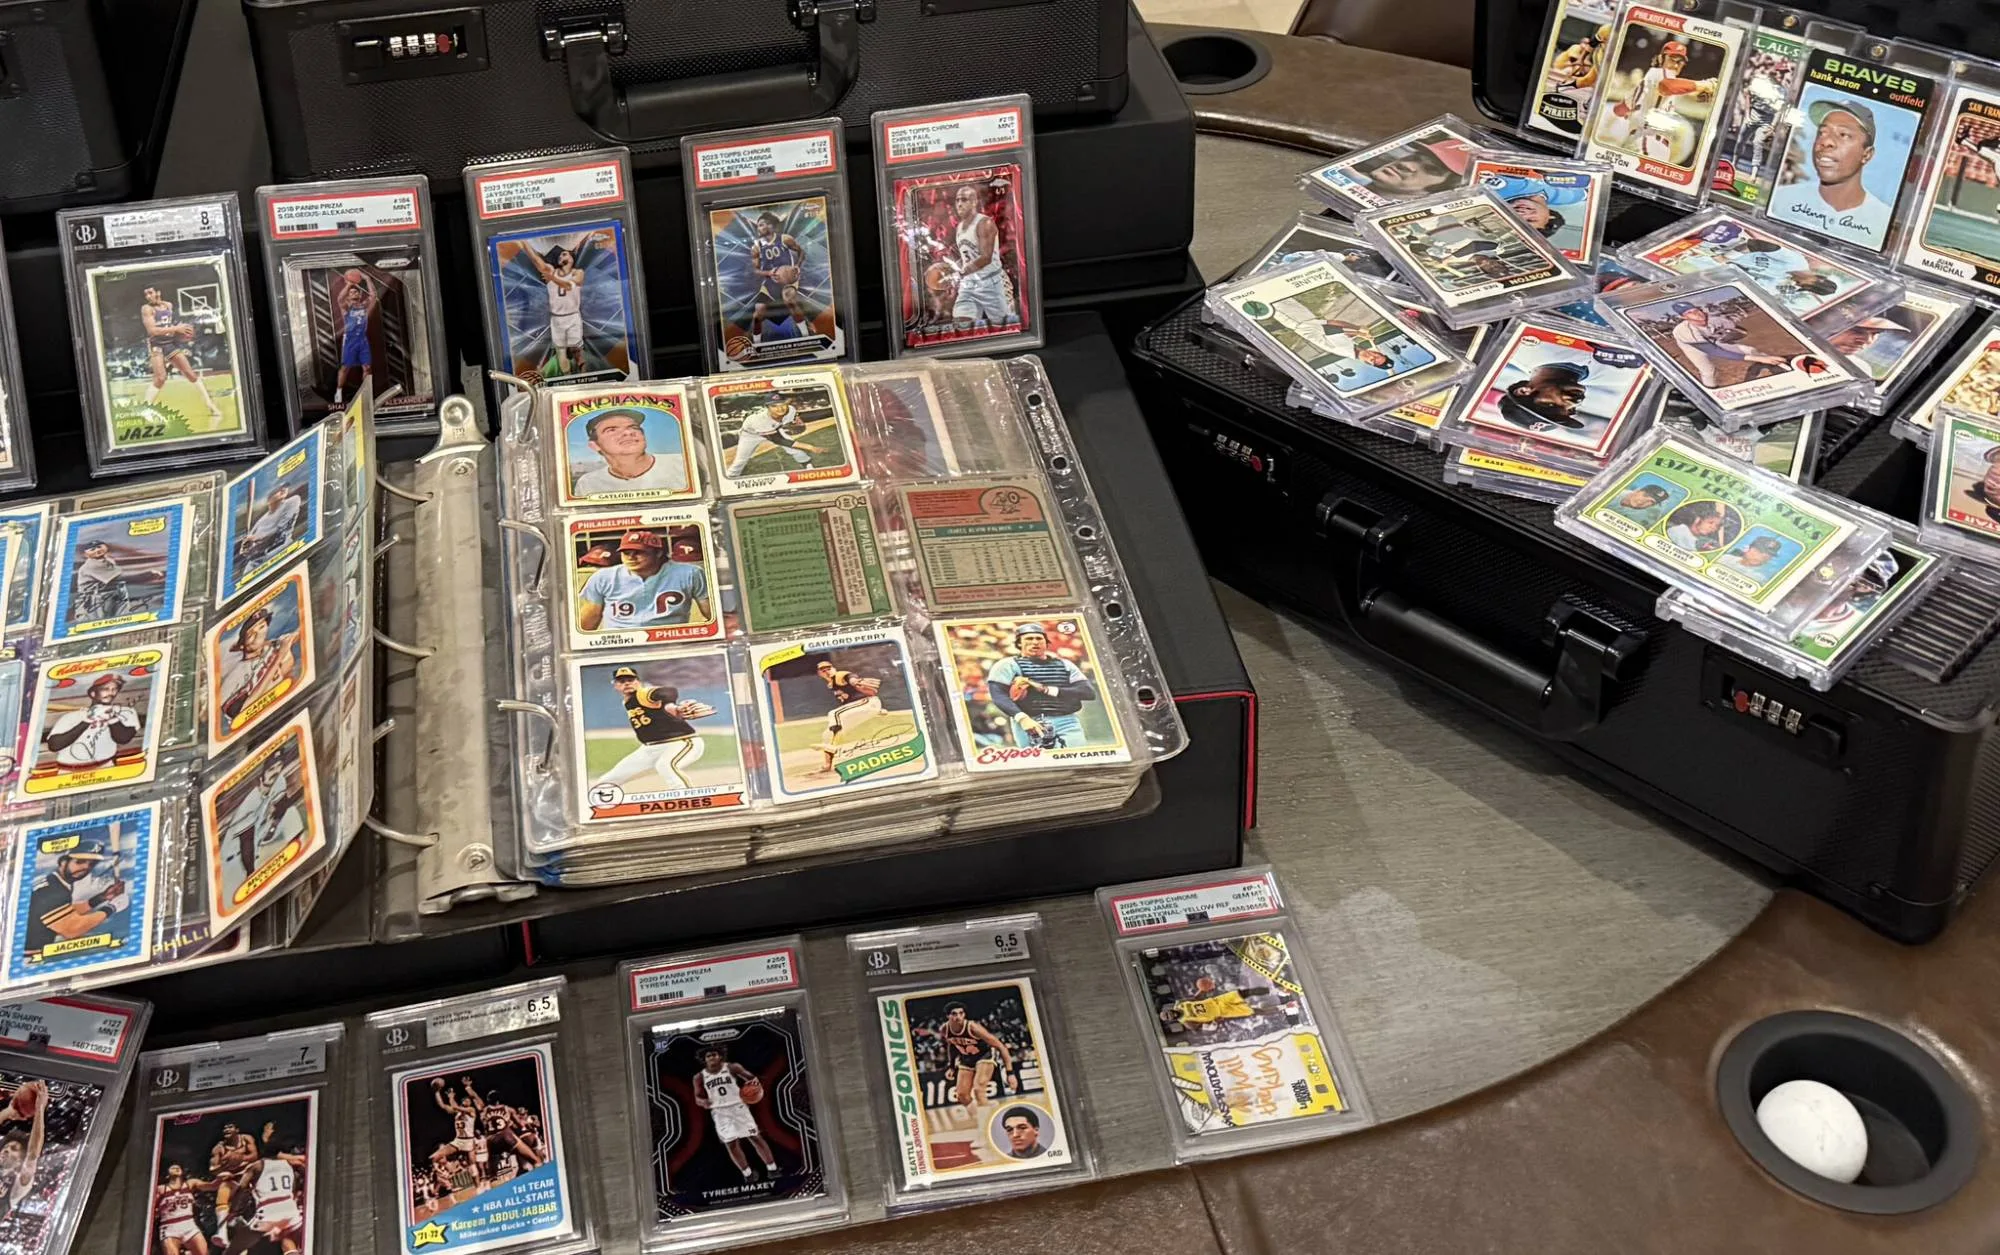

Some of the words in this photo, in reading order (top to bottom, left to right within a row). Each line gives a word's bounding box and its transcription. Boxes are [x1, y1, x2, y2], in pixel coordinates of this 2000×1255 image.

[1693, 25, 1725, 39] PITCHER
[1809, 69, 1832, 84] hank
[1833, 77, 1861, 92] aaron
[1824, 58, 1918, 96] BRAVES
[1888, 92, 1926, 109] outfield
[1967, 101, 1983, 114] SAN
[1542, 105, 1578, 121] PIRATES
[932, 122, 960, 132] CHROME
[997, 122, 1015, 130] MINT
[702, 157, 740, 168] JONATHAN
[741, 154, 773, 163] KUMINGA
[720, 151, 742, 161] TOPPS
[743, 147, 772, 156] CHROME
[1595, 153, 1631, 169] CARLTON
[596, 176, 614, 184] MINT
[1644, 163, 1686, 182] PHILLIES
[485, 189, 514, 199] JAYSON
[515, 186, 541, 196] TATUM
[502, 181, 526, 190] TOPPS
[295, 203, 320, 213] PANINI
[320, 201, 343, 211] PRIZM
[201, 211, 210, 226] 8
[1385, 215, 1405, 225] SOX
[1406, 211, 1428, 221] RED
[764, 246, 780, 261] 00
[1920, 259, 1965, 280] MARICHAL
[1936, 257, 1955, 270] JUAN
[1509, 271, 1553, 286] BOSTON
[783, 378, 816, 386] PITCHER
[568, 395, 676, 415] INDIANS
[118, 424, 167, 442] JAZZ
[1485, 458, 1505, 467] BASE
[797, 469, 844, 481] INDIANS
[577, 517, 638, 531] PHILADELPHIA
[651, 513, 693, 523] OUTFIELD
[859, 532, 876, 567] PALMER
[611, 601, 636, 618] 19
[655, 626, 709, 641] PHILLIES
[808, 636, 853, 650] GAYLORD
[854, 632, 887, 645] PERRY
[589, 636, 634, 647] LUZINSKI
[631, 715, 652, 730] 36
[846, 745, 915, 776] PADRES
[976, 748, 1042, 767] Expos
[1051, 751, 1078, 762] GARY
[1079, 749, 1117, 760] CARTER
[71, 772, 97, 782] RICE
[630, 789, 681, 803] GAYLORD
[683, 785, 718, 798] PERRY
[639, 797, 712, 814] PADRES
[246, 846, 288, 889] MUNSON
[1140, 898, 1165, 908] TOPPS
[1165, 893, 1199, 904] CHROME
[1232, 892, 1250, 901] GEM
[1152, 902, 1179, 913] JAMES
[53, 936, 102, 953] JACKSON
[152, 930, 211, 957] PHILLI
[994, 932, 1018, 949] 6.5
[658, 971, 686, 982] PANINI
[686, 967, 712, 978] PRIZM
[765, 962, 787, 972] MINT
[639, 979, 670, 990] TYRESE
[670, 975, 701, 986] MAXEY
[527, 995, 551, 1013] 6.5
[98, 1026, 119, 1037] MINT
[299, 1046, 310, 1063] 7
[881, 999, 919, 1118] SONICS
[718, 1085, 728, 1097] 0
[909, 1140, 920, 1177] SEATTLE
[1047, 1149, 1064, 1159] GRD
[269, 1175, 292, 1193] 10
[513, 1183, 528, 1195] 1st
[528, 1178, 555, 1192] TEAM
[701, 1186, 739, 1199] TYRESE
[740, 1180, 777, 1194] MAXEY
[483, 1200, 503, 1213] NBA
[504, 1188, 556, 1209] ALL-STARS
[451, 1215, 487, 1232] Kareem
[489, 1201, 558, 1224] ABDUL-JABBAR
[501, 1217, 527, 1234] Bucks
